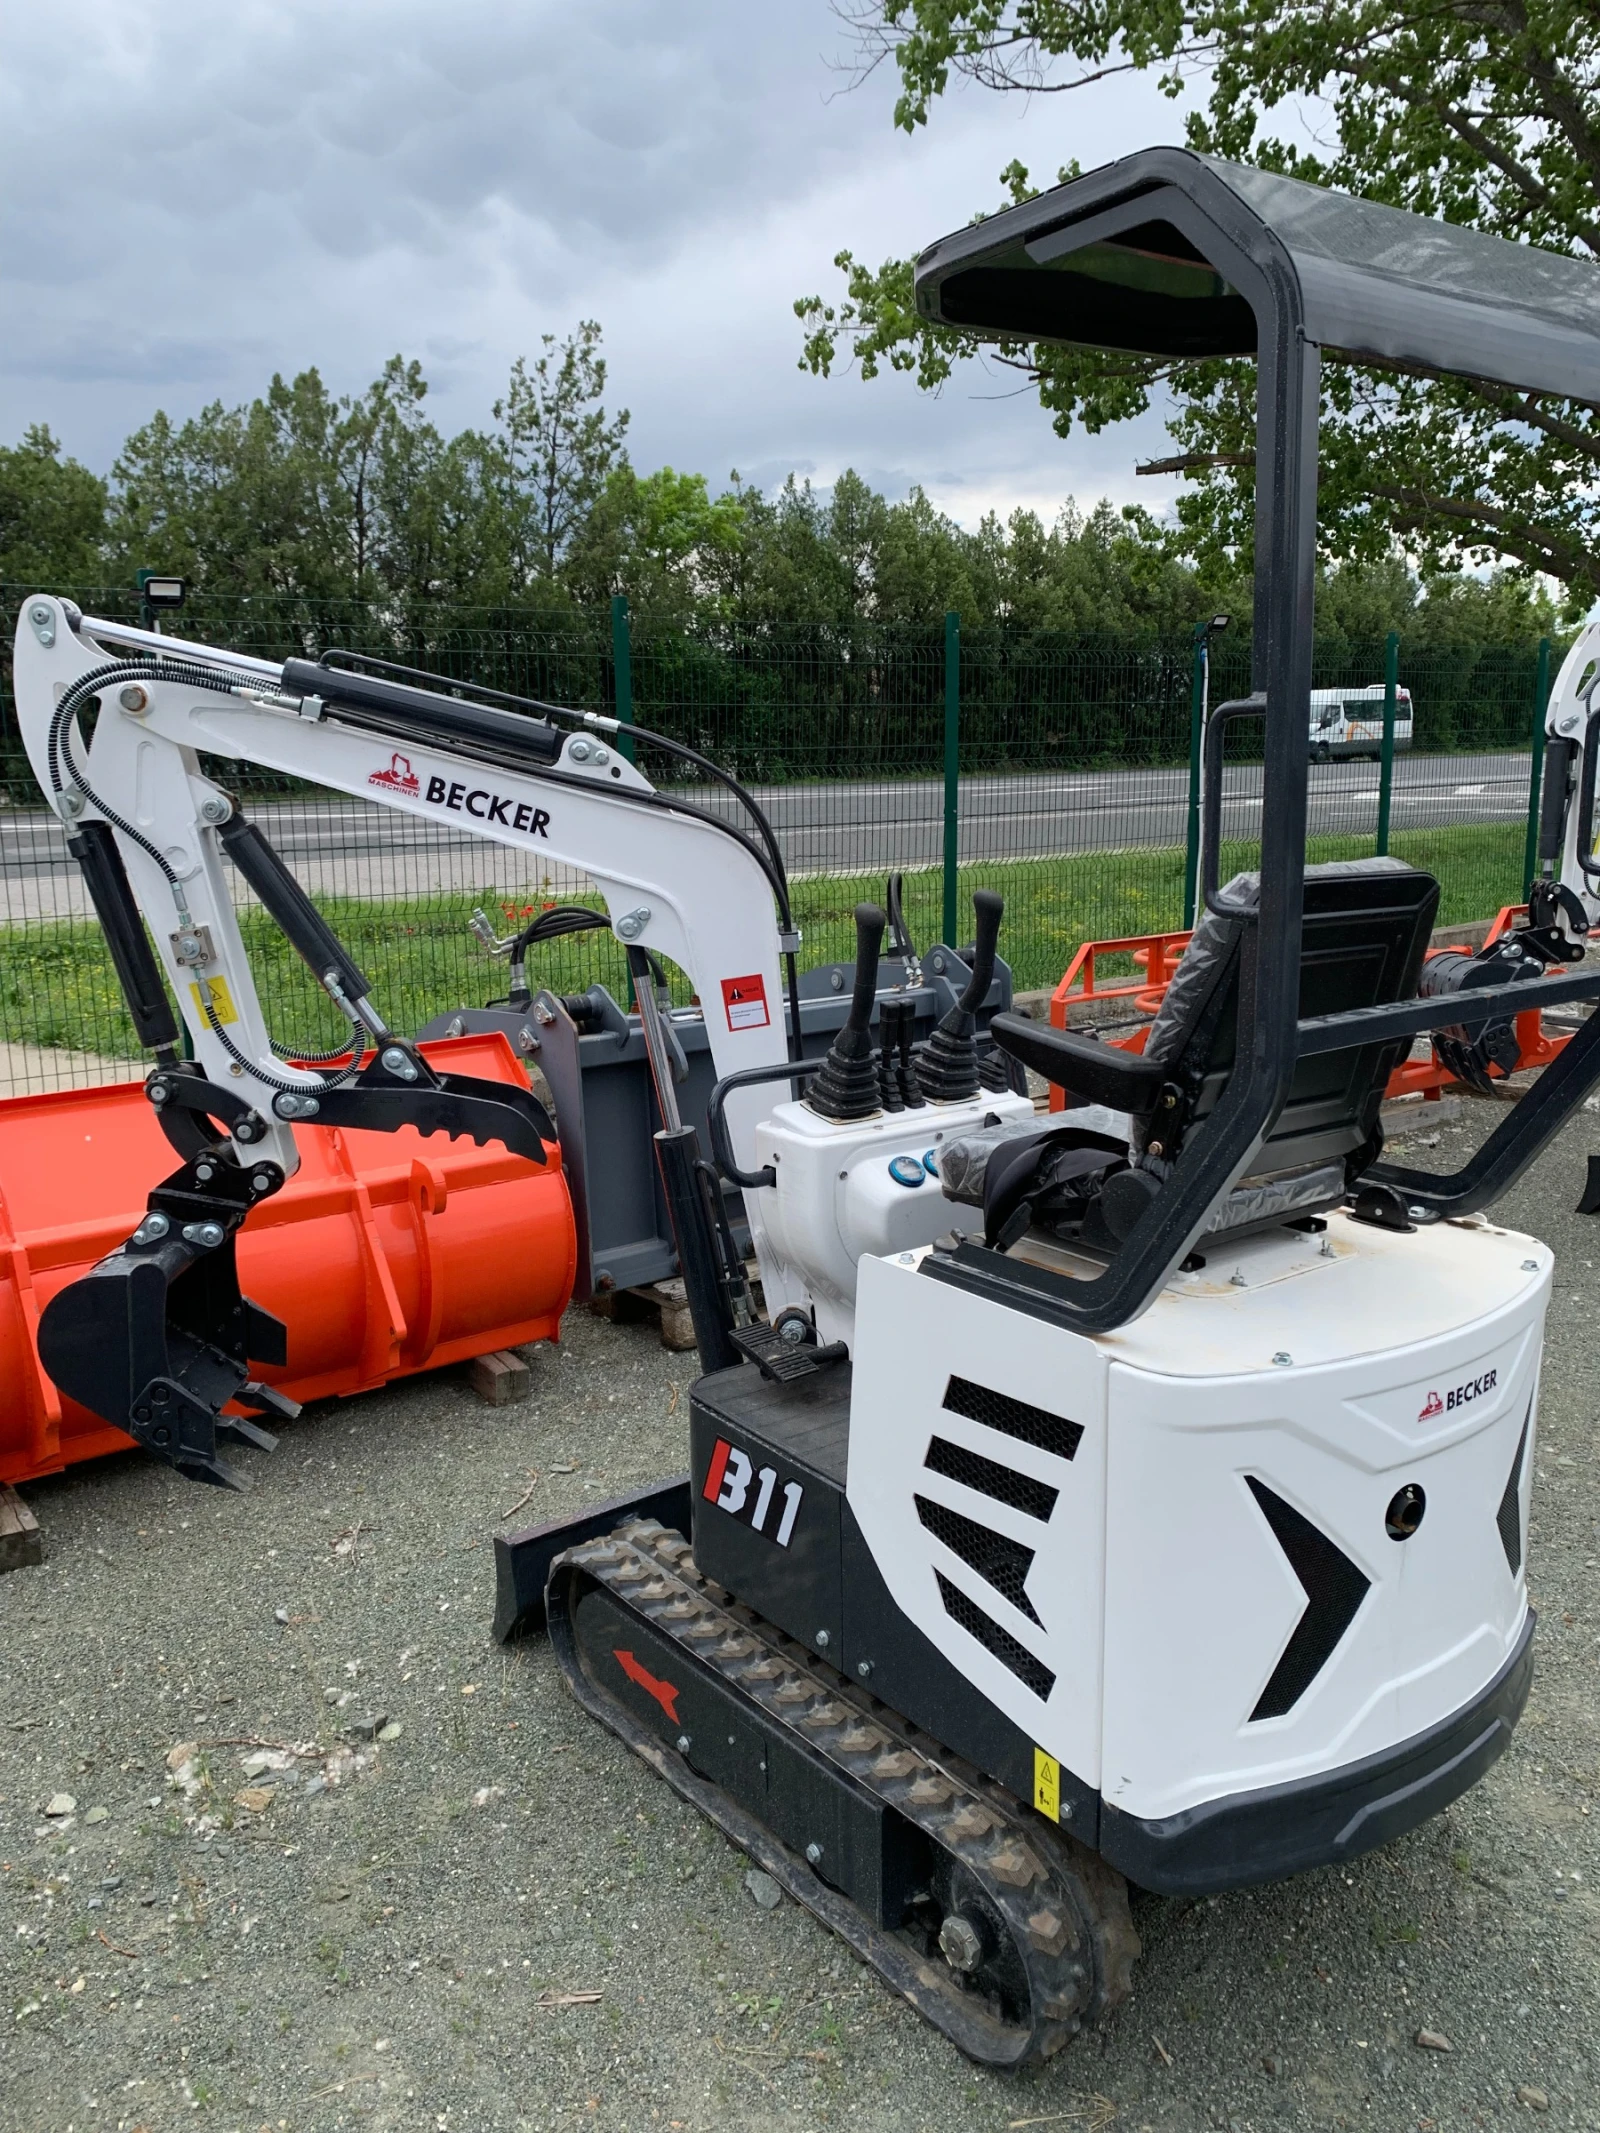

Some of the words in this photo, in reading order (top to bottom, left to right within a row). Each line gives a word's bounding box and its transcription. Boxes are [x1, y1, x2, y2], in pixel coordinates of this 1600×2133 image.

[367, 778, 420, 798] MASCHINEN
[425, 776, 550, 838] BECKER
[1446, 1369, 1497, 1411] BECKER
